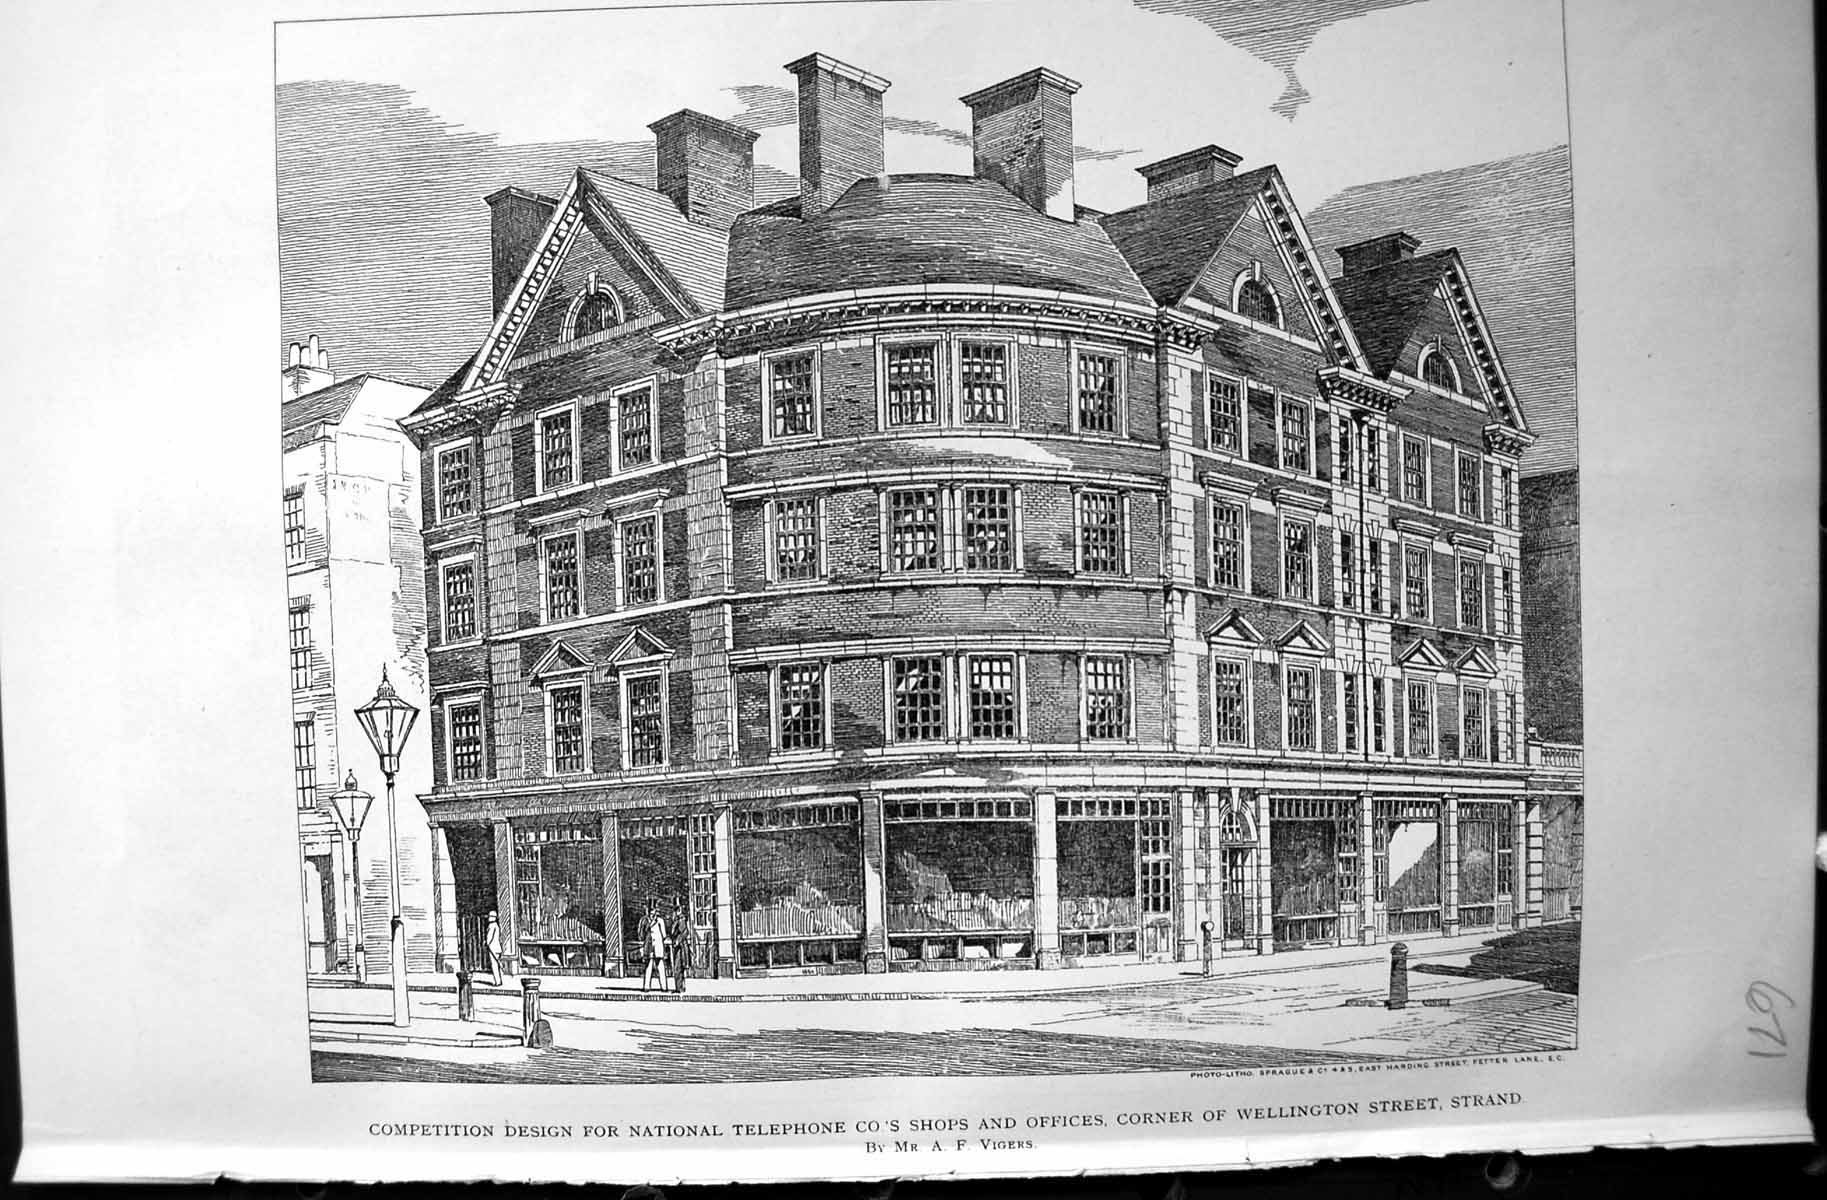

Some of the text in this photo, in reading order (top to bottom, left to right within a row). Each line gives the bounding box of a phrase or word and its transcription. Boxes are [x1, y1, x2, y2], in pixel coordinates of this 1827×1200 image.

[1259, 1068, 1305, 1077] SPRAGUE
[1358, 1064, 1382, 1073] EAST
[1386, 1062, 1430, 1071] HARDING
[1472, 1057, 1508, 1066] FETTER
[369, 1123, 495, 1138] COMPETITION
[504, 1124, 573, 1138] DESIGN
[583, 1125, 620, 1138] FOR
[629, 1124, 724, 1137] NATIONAL
[732, 1121, 846, 1136] TELEPHONE
[909, 1118, 969, 1133] SHOPS
[978, 1116, 1018, 1131] AND
[1116, 1111, 1193, 1126] CORNER
[1202, 1109, 1227, 1123] OF
[1237, 1102, 1359, 1120] WELLINGTON
[1368, 1097, 1444, 1114] STREET,
